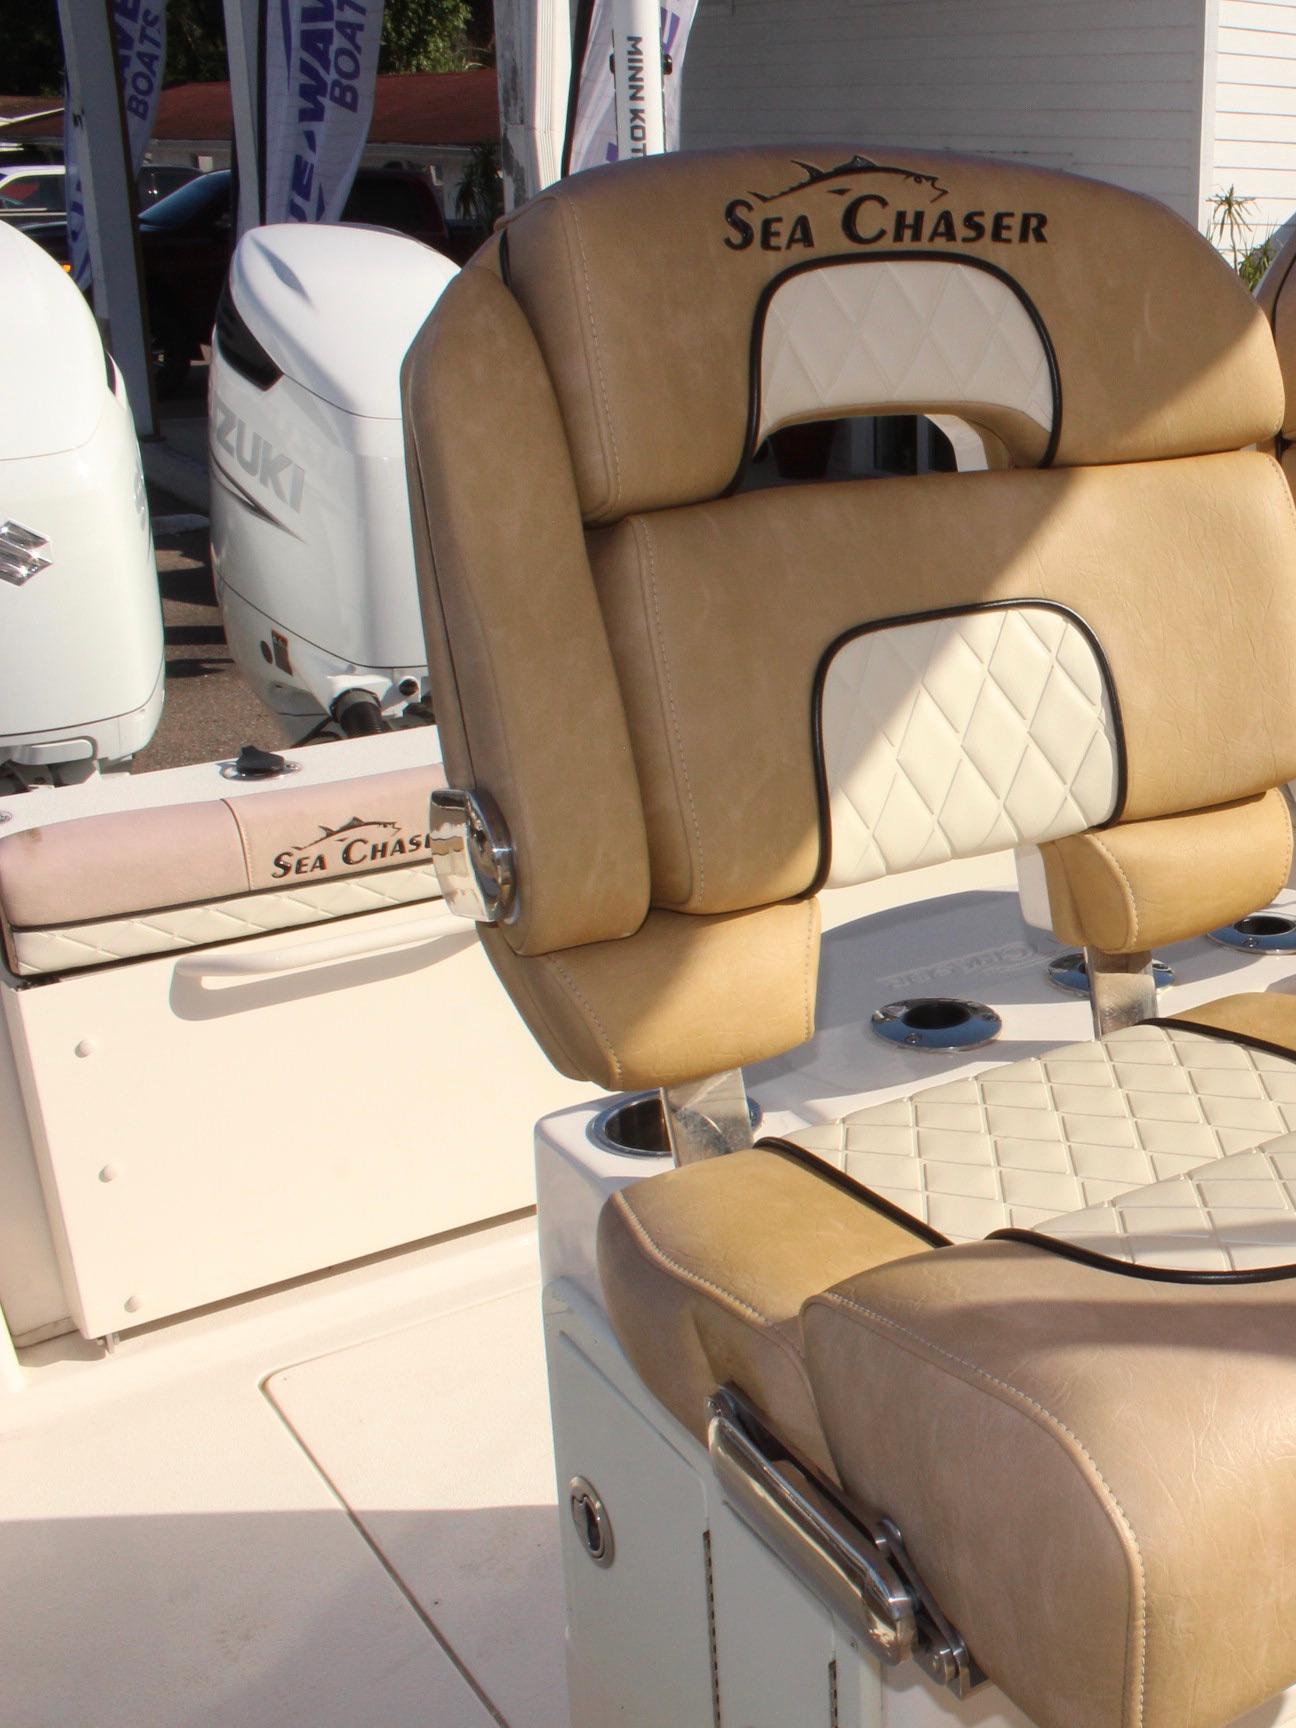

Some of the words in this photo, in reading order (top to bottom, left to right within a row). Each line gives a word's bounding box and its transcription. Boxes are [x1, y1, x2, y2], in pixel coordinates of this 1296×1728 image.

[126, 8, 161, 121] BOATS
[626, 36, 645, 102] MINN
[724, 199, 815, 251] SEA
[841, 194, 1048, 245] CHASER
[271, 851, 327, 878] SEA
